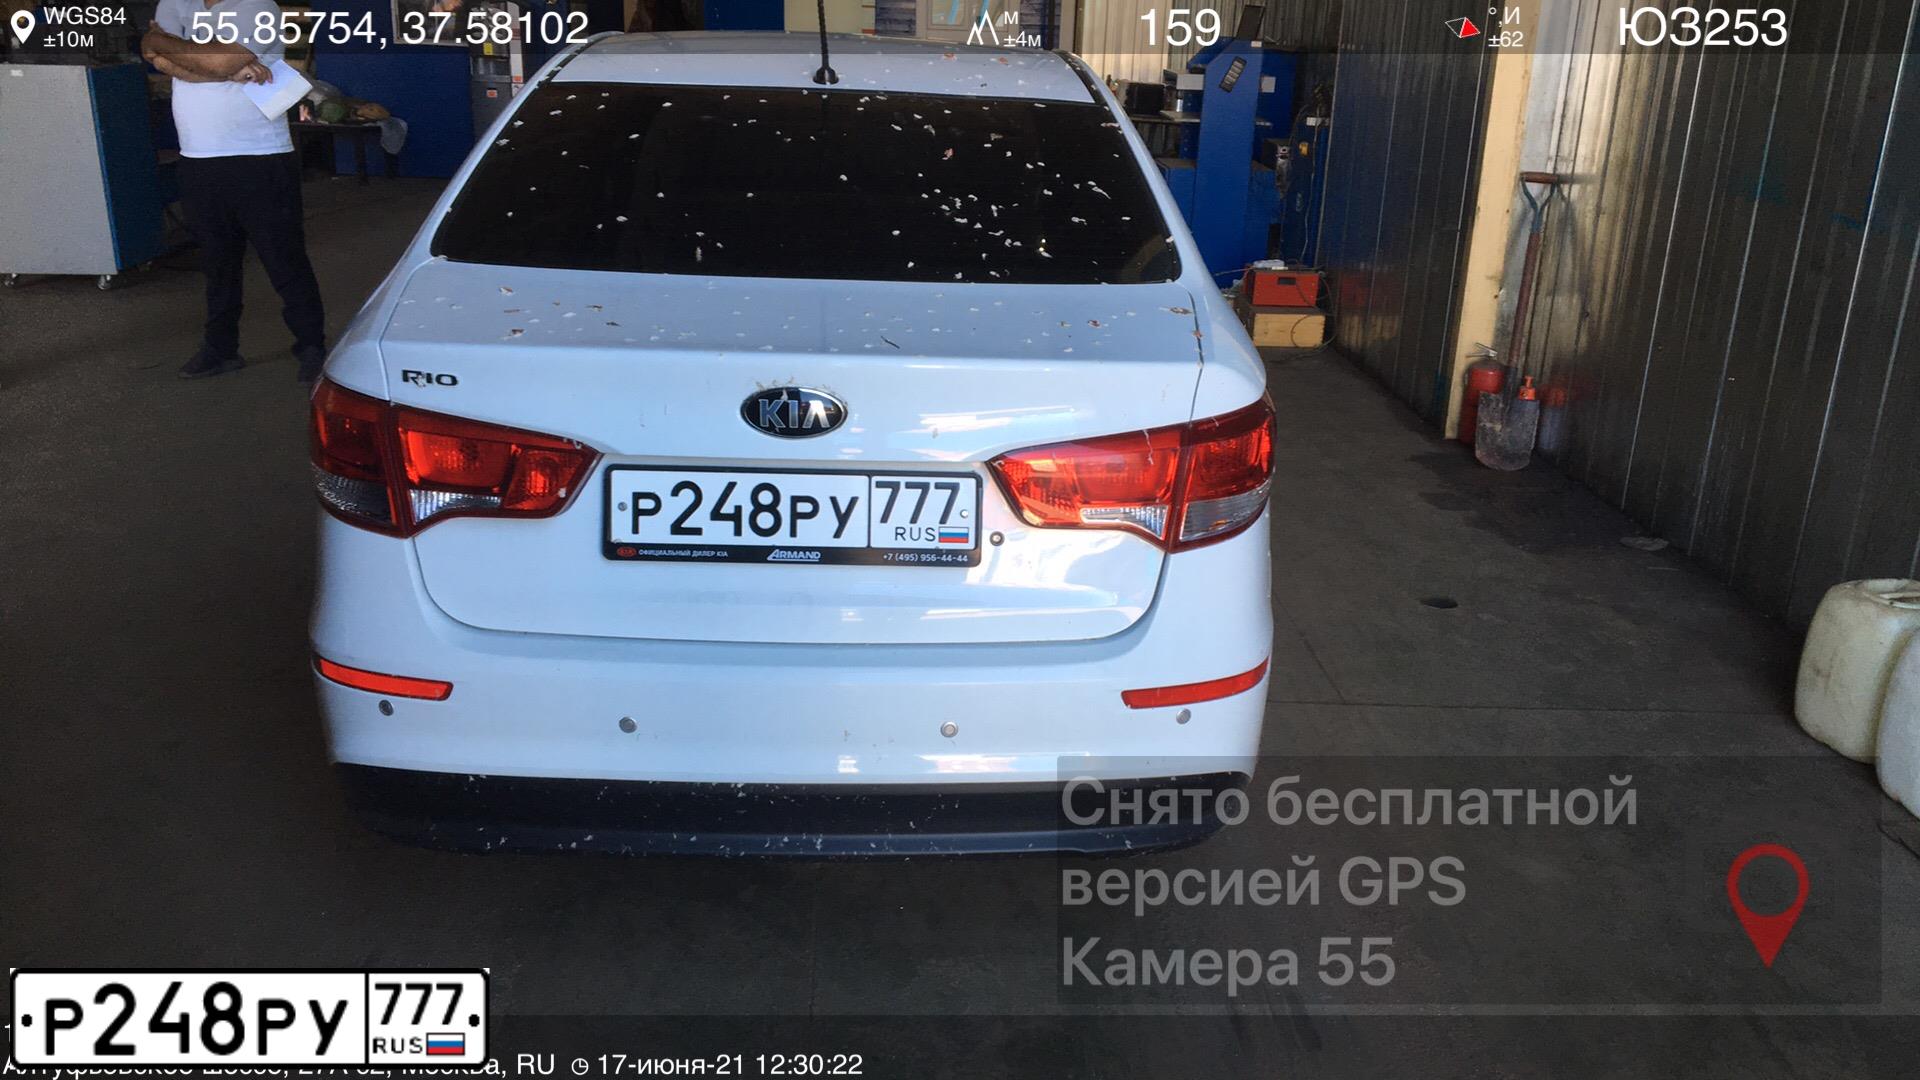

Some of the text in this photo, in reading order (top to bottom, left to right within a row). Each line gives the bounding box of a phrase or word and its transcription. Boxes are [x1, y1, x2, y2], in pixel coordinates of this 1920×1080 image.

[401, 368, 460, 388] RIO
[757, 398, 832, 429] KIA
[874, 480, 961, 525] 777
[894, 526, 937, 543] RUS
[766, 549, 821, 561] ARMAND
[883, 553, 969, 563] +7 (495) 956-44-44
